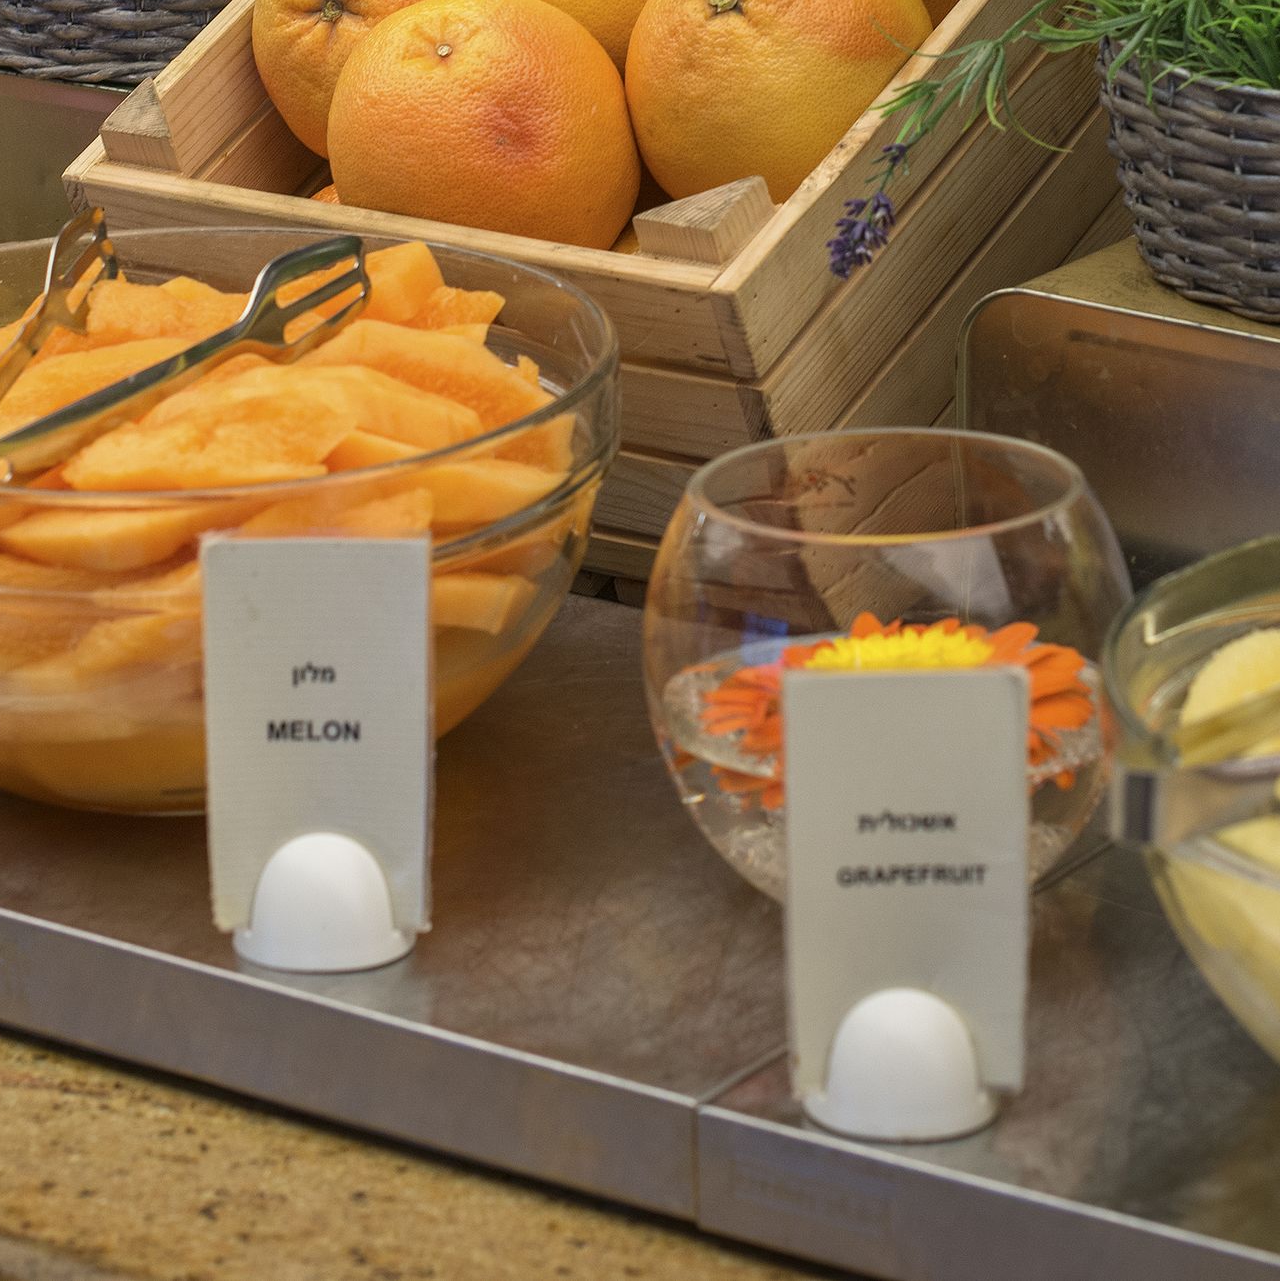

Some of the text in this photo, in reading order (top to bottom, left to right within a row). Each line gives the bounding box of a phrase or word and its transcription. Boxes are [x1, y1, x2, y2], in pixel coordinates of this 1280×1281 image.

[291, 662, 337, 688] מלון
[266, 720, 361, 742] MELON
[836, 864, 986, 888] GRAPEFRUIT
